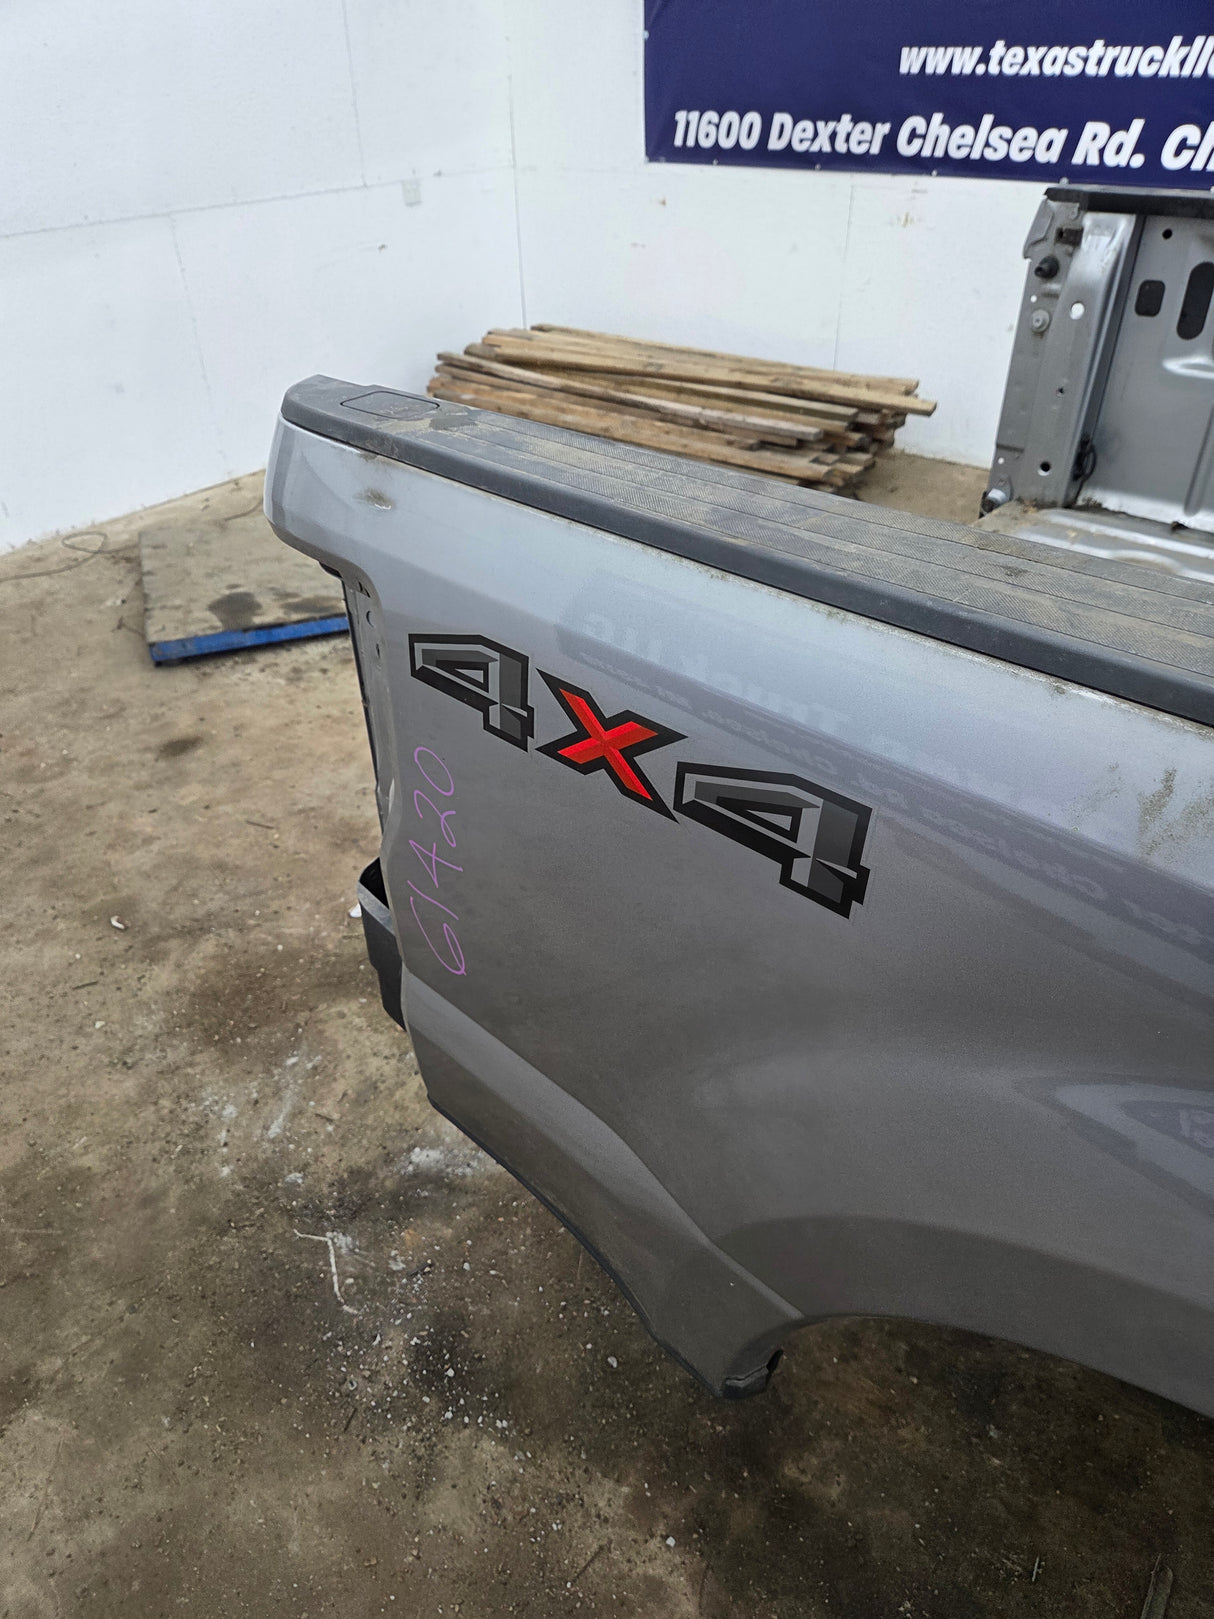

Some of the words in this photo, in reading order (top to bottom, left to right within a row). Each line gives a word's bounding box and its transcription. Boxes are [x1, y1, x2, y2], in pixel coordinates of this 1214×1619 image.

[899, 35, 1214, 78] www.texastruckll
[673, 110, 762, 150] 11600
[767, 112, 891, 155] Dexter
[896, 112, 1069, 163] Chelsea
[1071, 118, 1146, 168] Rd.
